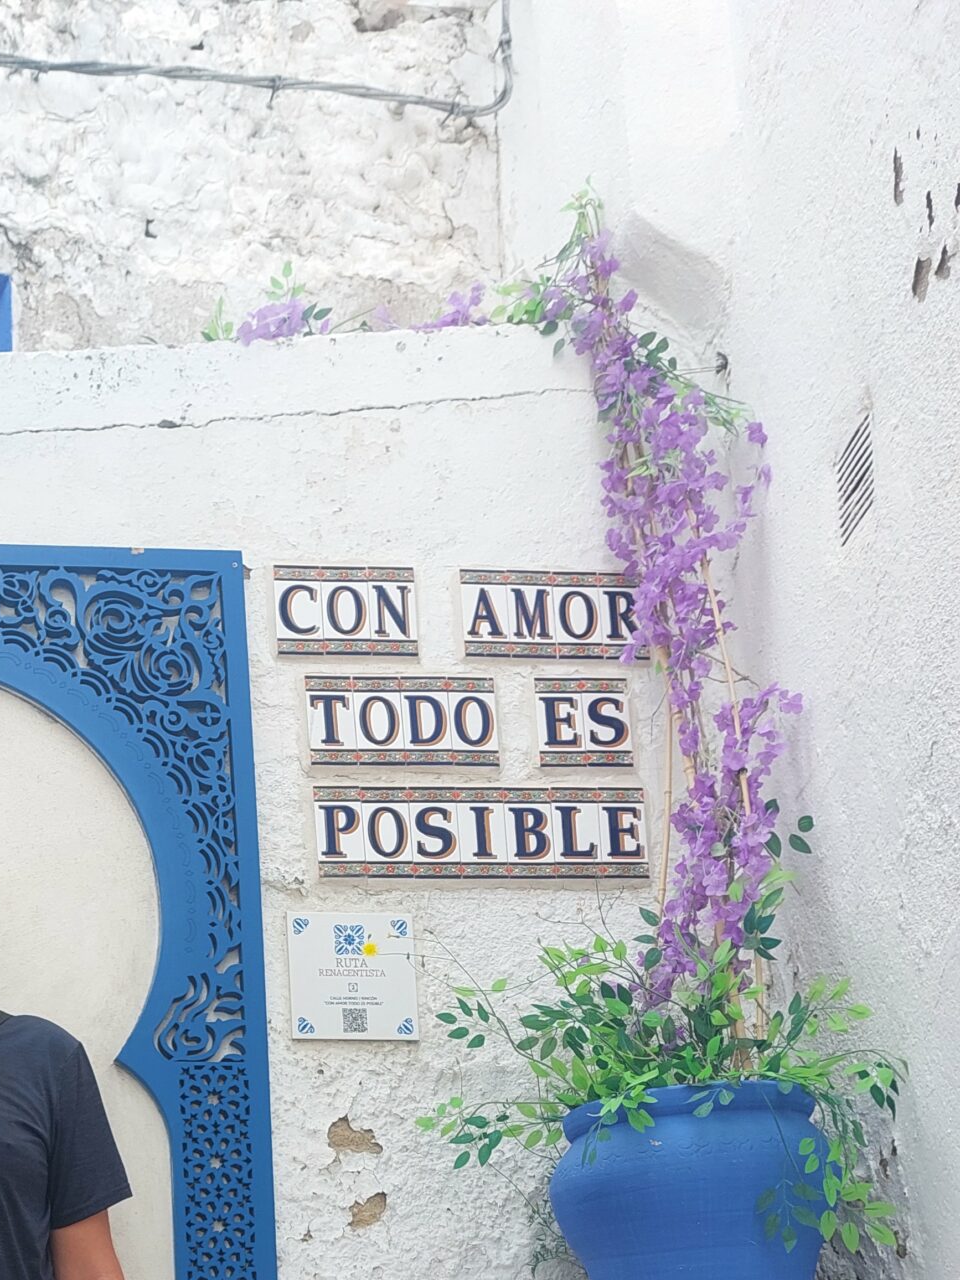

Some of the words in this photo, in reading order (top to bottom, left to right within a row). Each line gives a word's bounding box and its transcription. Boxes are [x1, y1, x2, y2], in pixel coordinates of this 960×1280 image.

[278, 584, 412, 638] CON
[467, 587, 638, 641] AMOR
[309, 694, 495, 747] TODO
[539, 696, 629, 748] ES
[318, 804, 645, 860] POSIBLE
[318, 968, 386, 977] RENACENTISTA
[336, 957, 369, 968] RUTA
